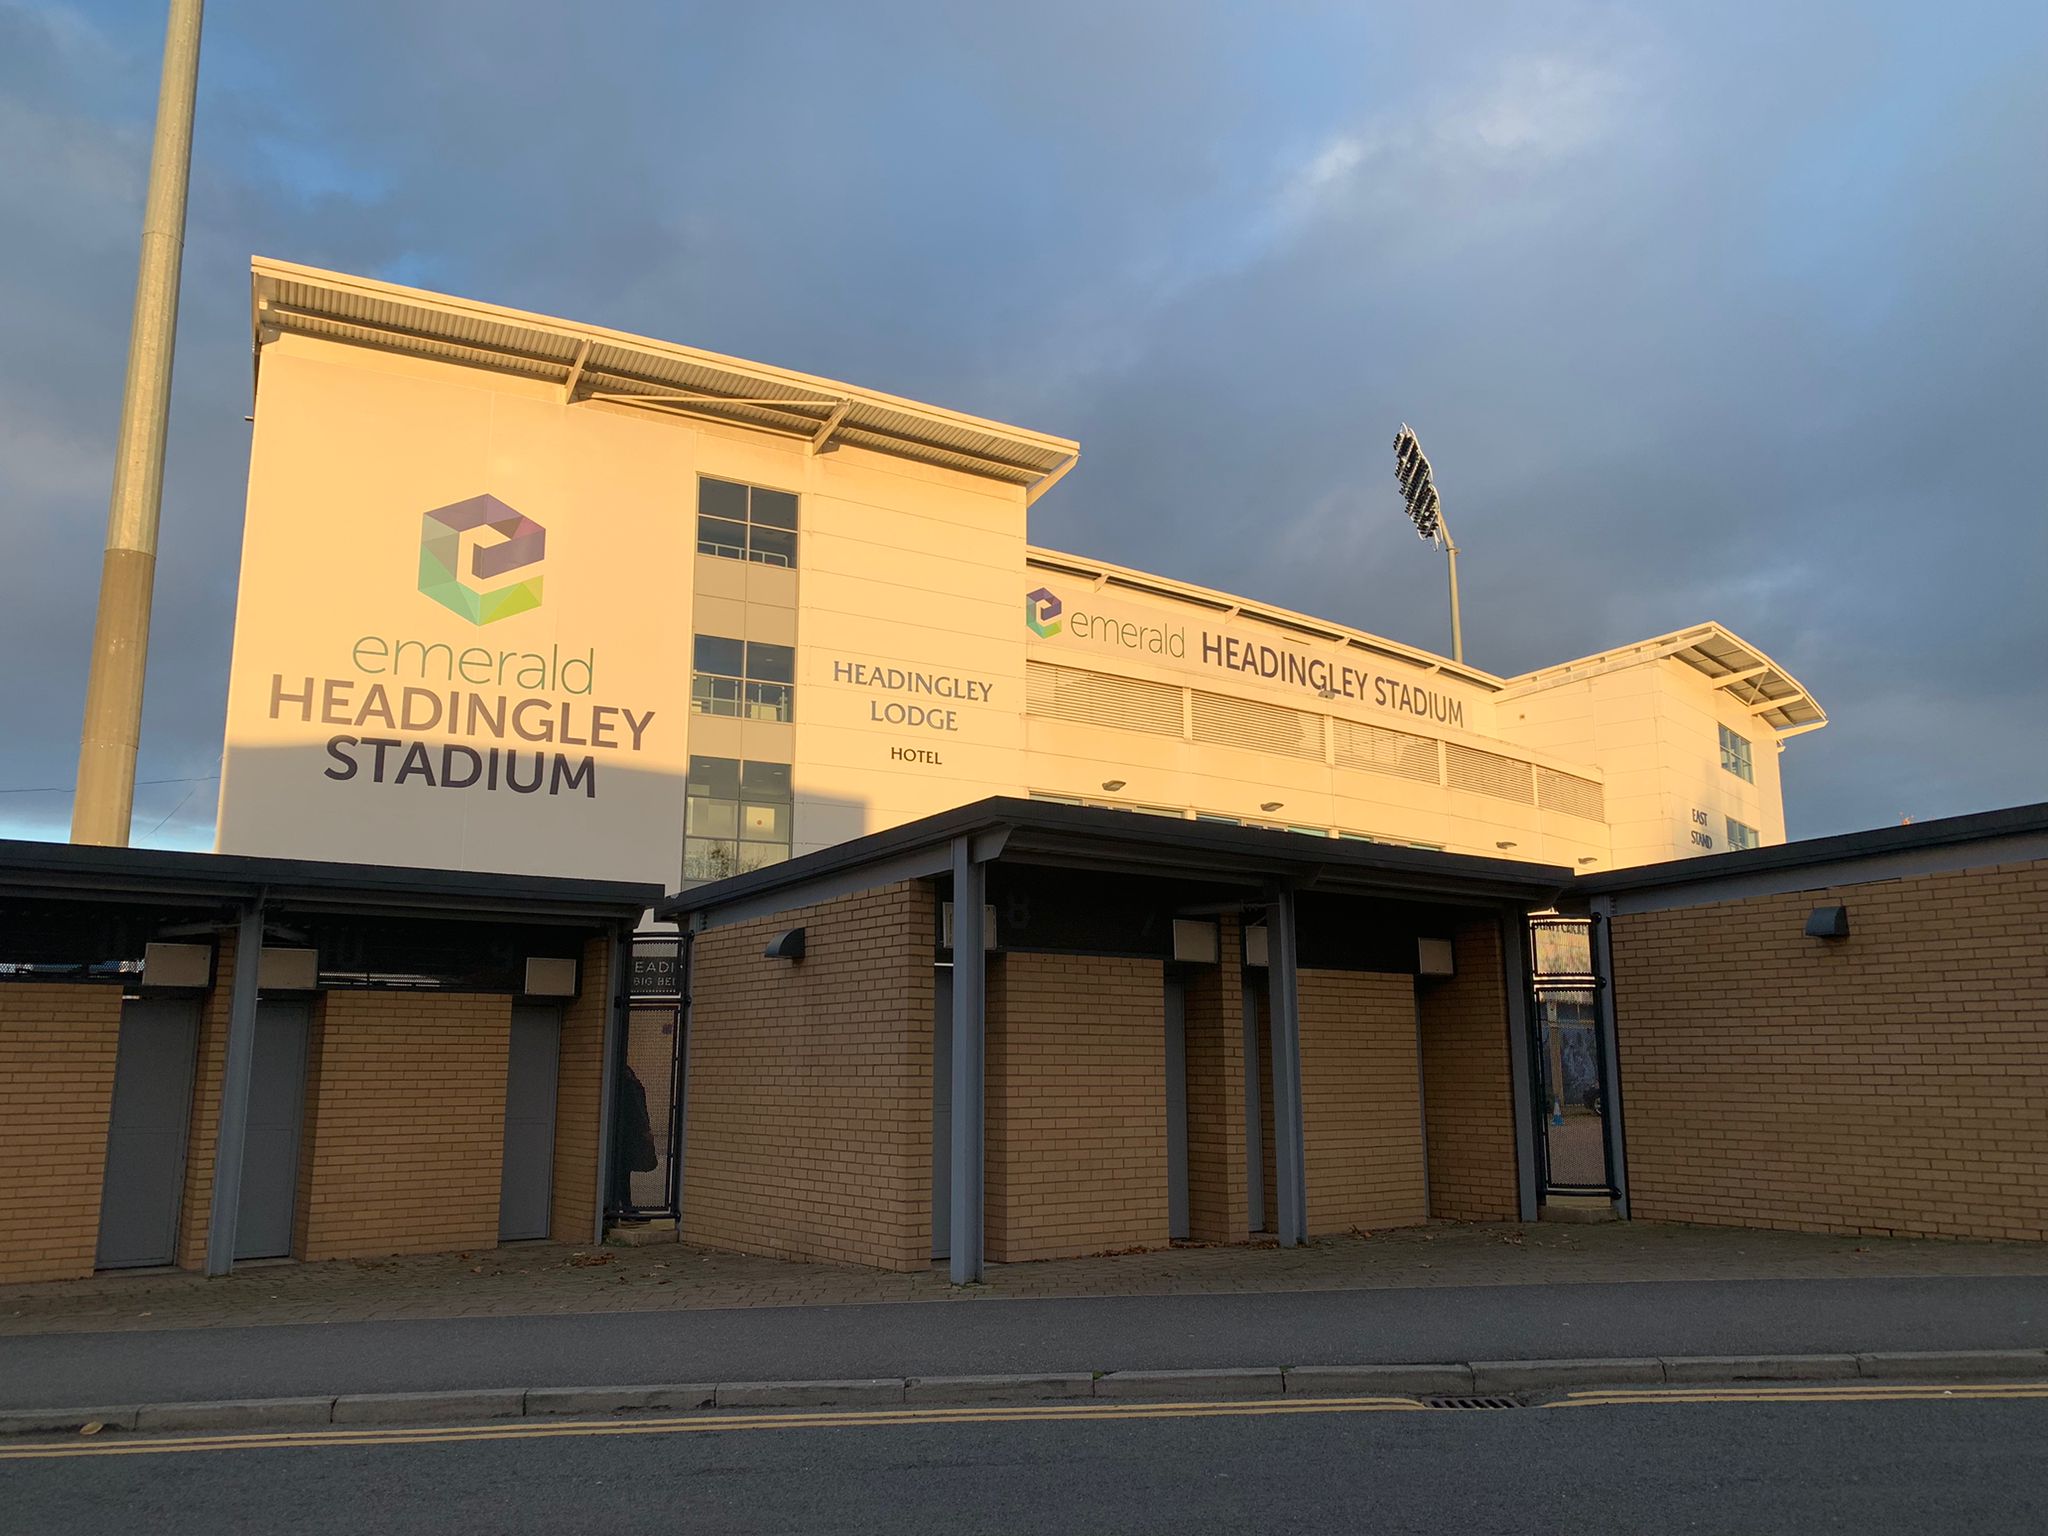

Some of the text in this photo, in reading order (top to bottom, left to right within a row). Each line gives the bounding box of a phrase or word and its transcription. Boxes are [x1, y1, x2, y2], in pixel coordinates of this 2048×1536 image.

[352, 635, 595, 695] emerald
[833, 660, 993, 703] HEADINGLEY
[1070, 611, 1464, 728] emerald HEADINGLEY STADIUM
[268, 673, 656, 751] HEADINGLEY
[871, 700, 959, 732] LODGE
[323, 734, 596, 799] STADIUM
[890, 746, 943, 765] HOTEL
[1691, 807, 1708, 827] EAST
[1690, 829, 1713, 850] STAND
